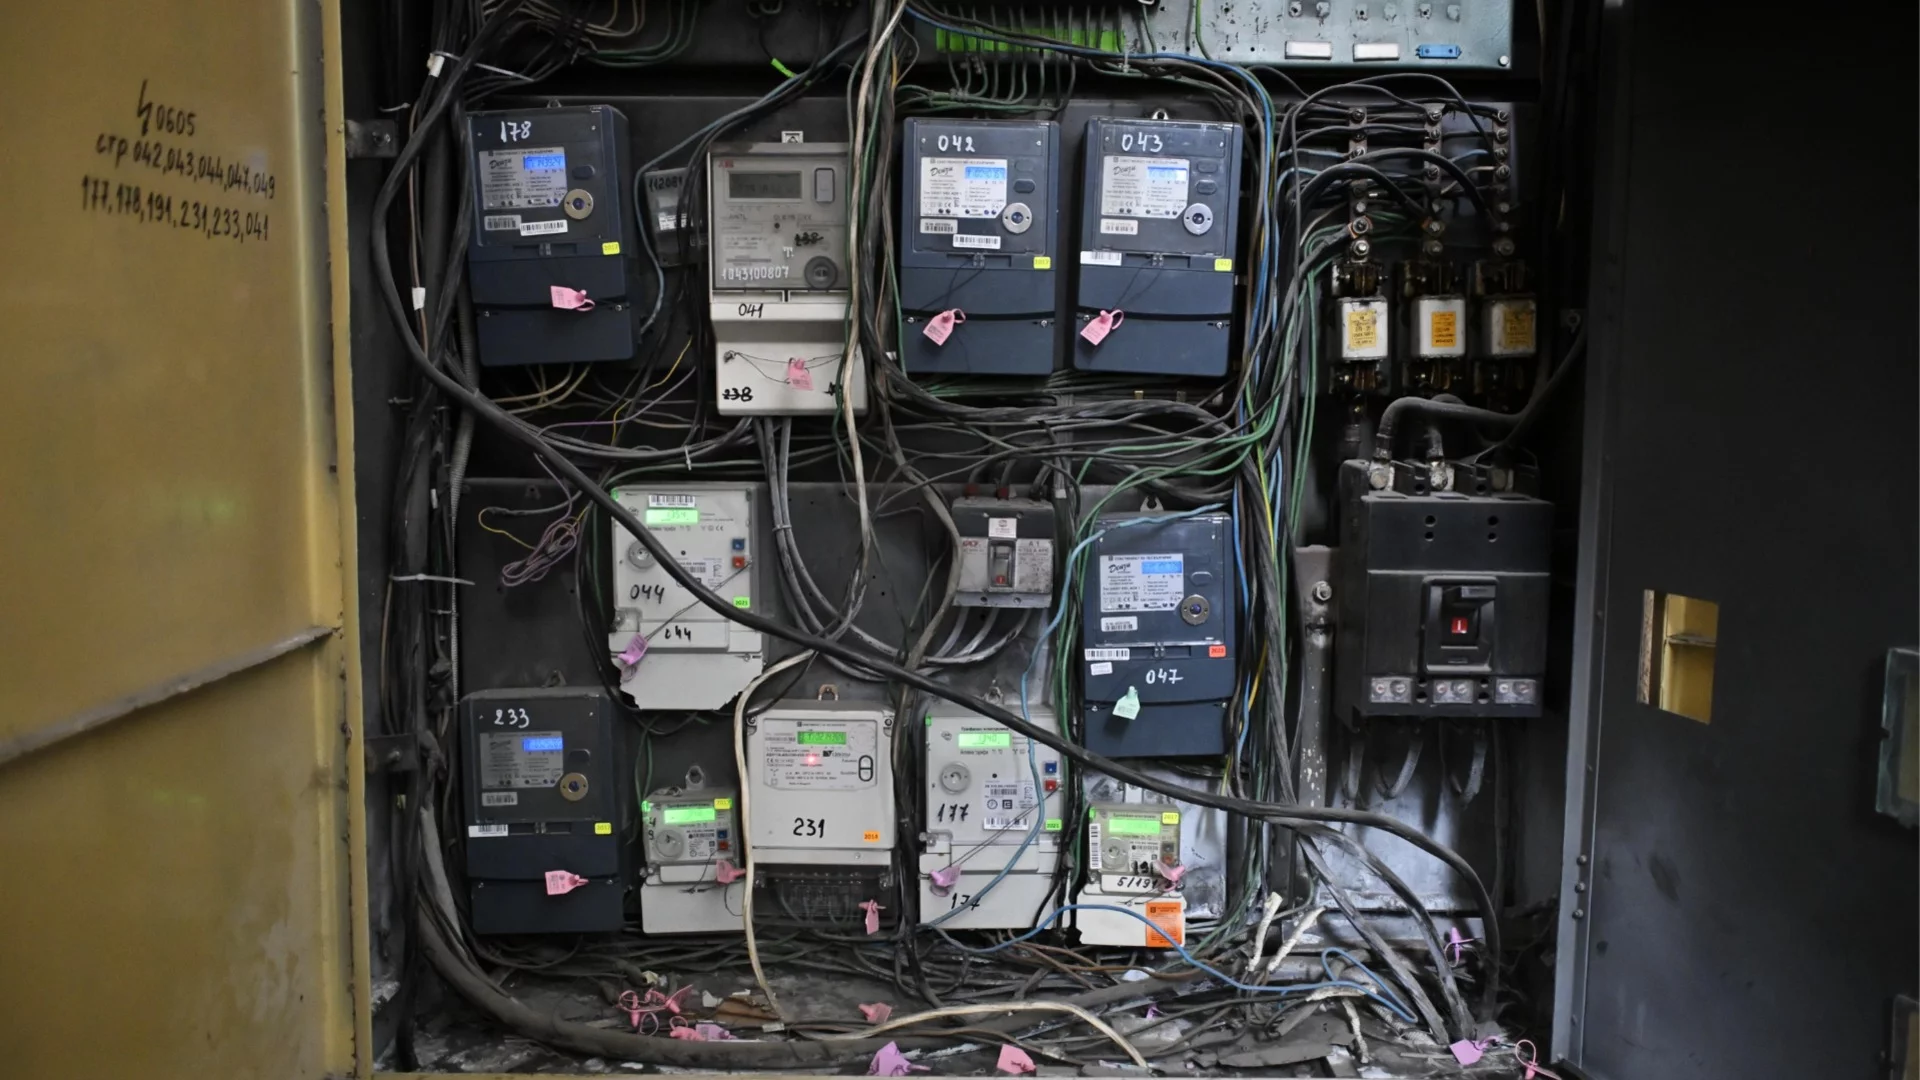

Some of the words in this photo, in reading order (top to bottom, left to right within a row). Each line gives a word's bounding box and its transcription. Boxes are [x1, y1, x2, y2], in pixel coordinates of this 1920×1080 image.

[156, 104, 196, 136] 0605
[500, 121, 532, 143] 178
[1121, 132, 1164, 152] 043
[938, 135, 976, 153] 042
[738, 303, 764, 318] 041
[630, 584, 665, 604] 044
[1145, 668, 1184, 684] 047
[494, 708, 530, 728] 233
[937, 803, 969, 822] 177
[793, 817, 825, 838] 231
